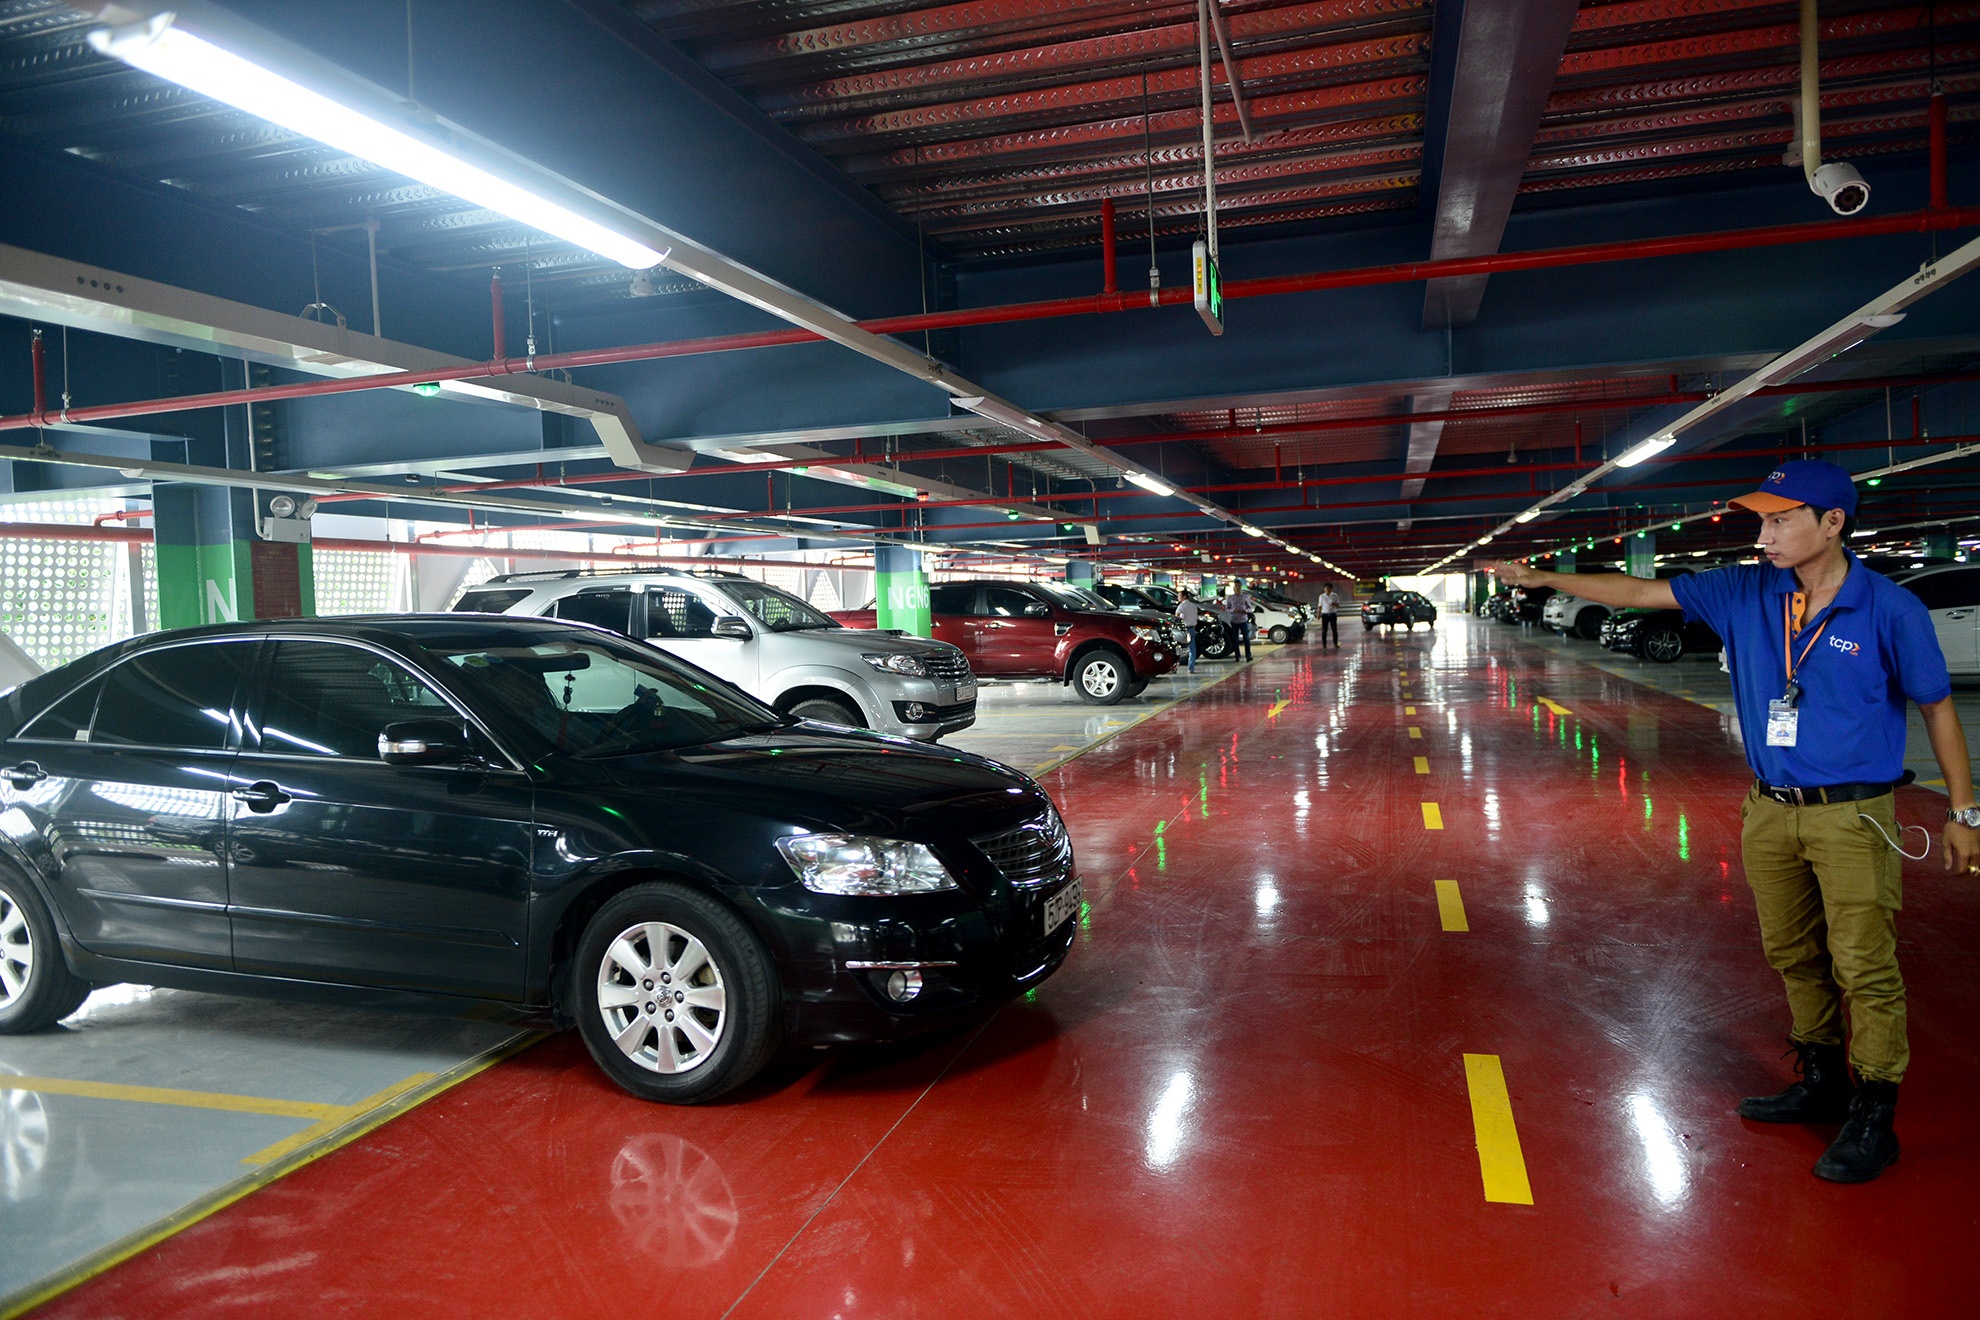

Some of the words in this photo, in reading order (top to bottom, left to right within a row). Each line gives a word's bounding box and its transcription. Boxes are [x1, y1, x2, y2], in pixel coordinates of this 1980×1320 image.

[1631, 563, 1655, 579] M5
[887, 585, 916, 610] N6
[917, 585, 929, 609] N6
